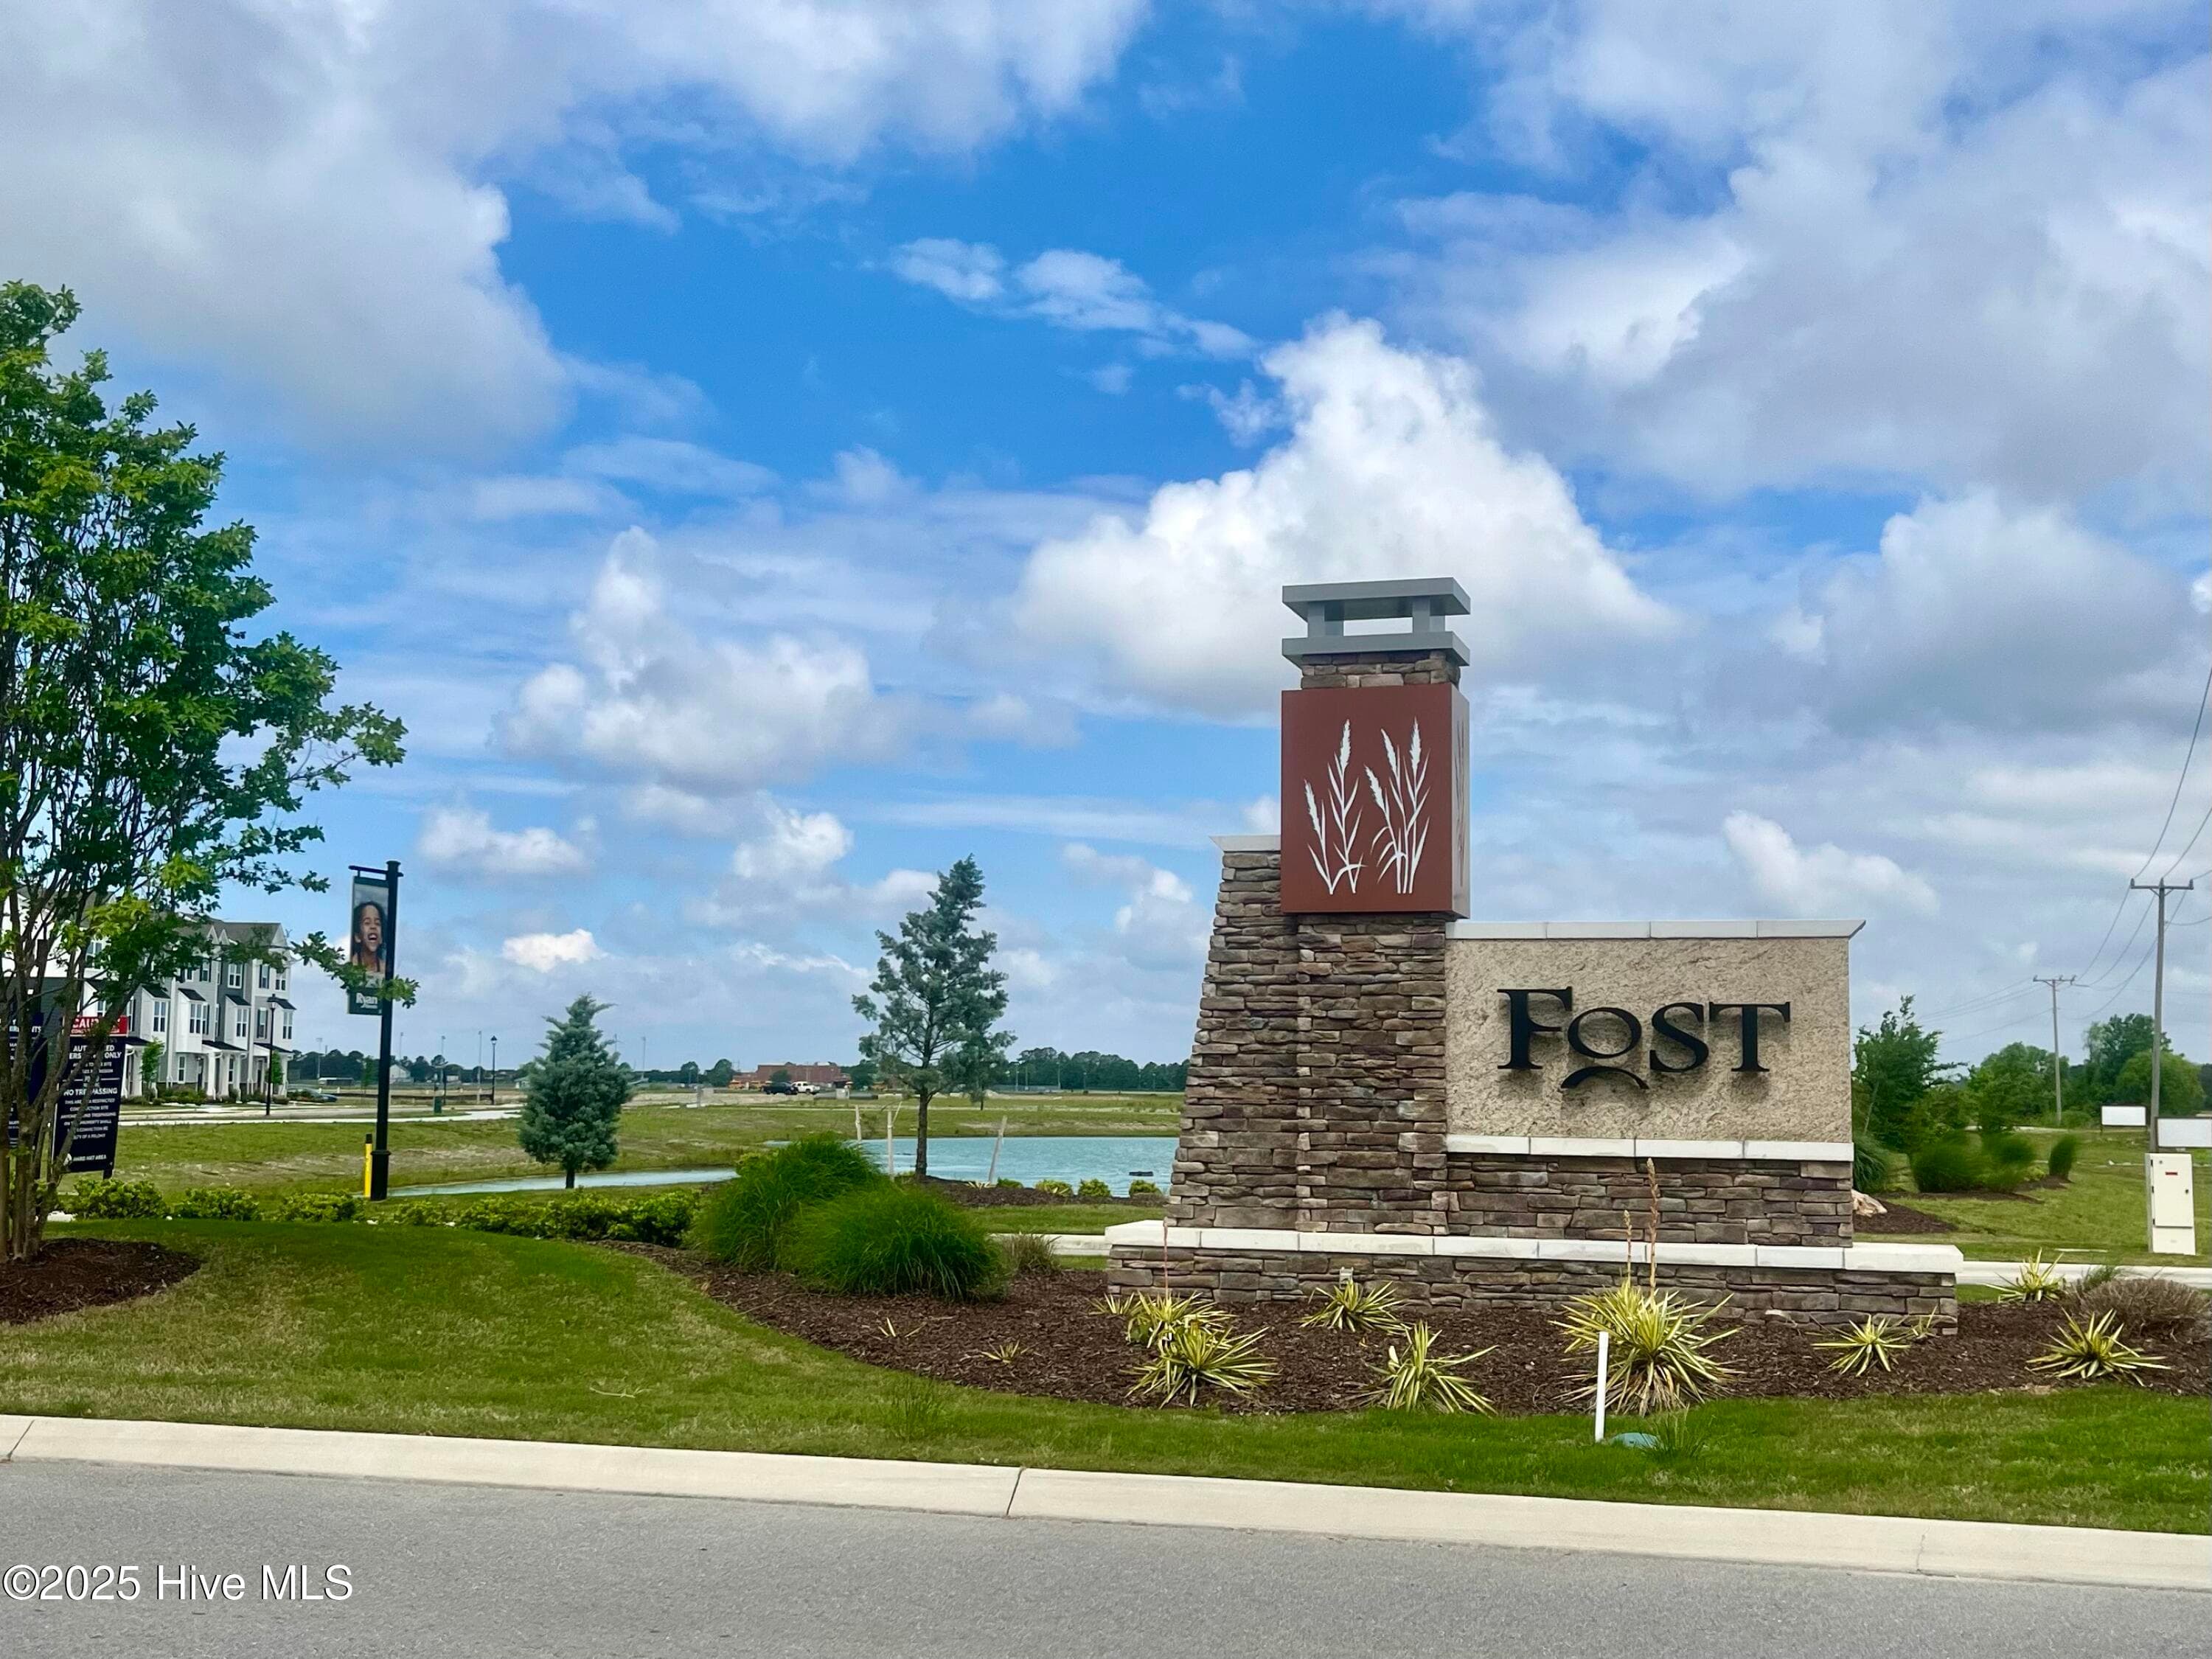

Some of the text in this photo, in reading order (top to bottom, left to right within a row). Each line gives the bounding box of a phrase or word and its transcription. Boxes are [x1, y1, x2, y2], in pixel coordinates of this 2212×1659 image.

[355, 992, 378, 1008] Ryan
[1497, 986, 1791, 1074] FOST
[75, 1087, 118, 1096] TREASSING
